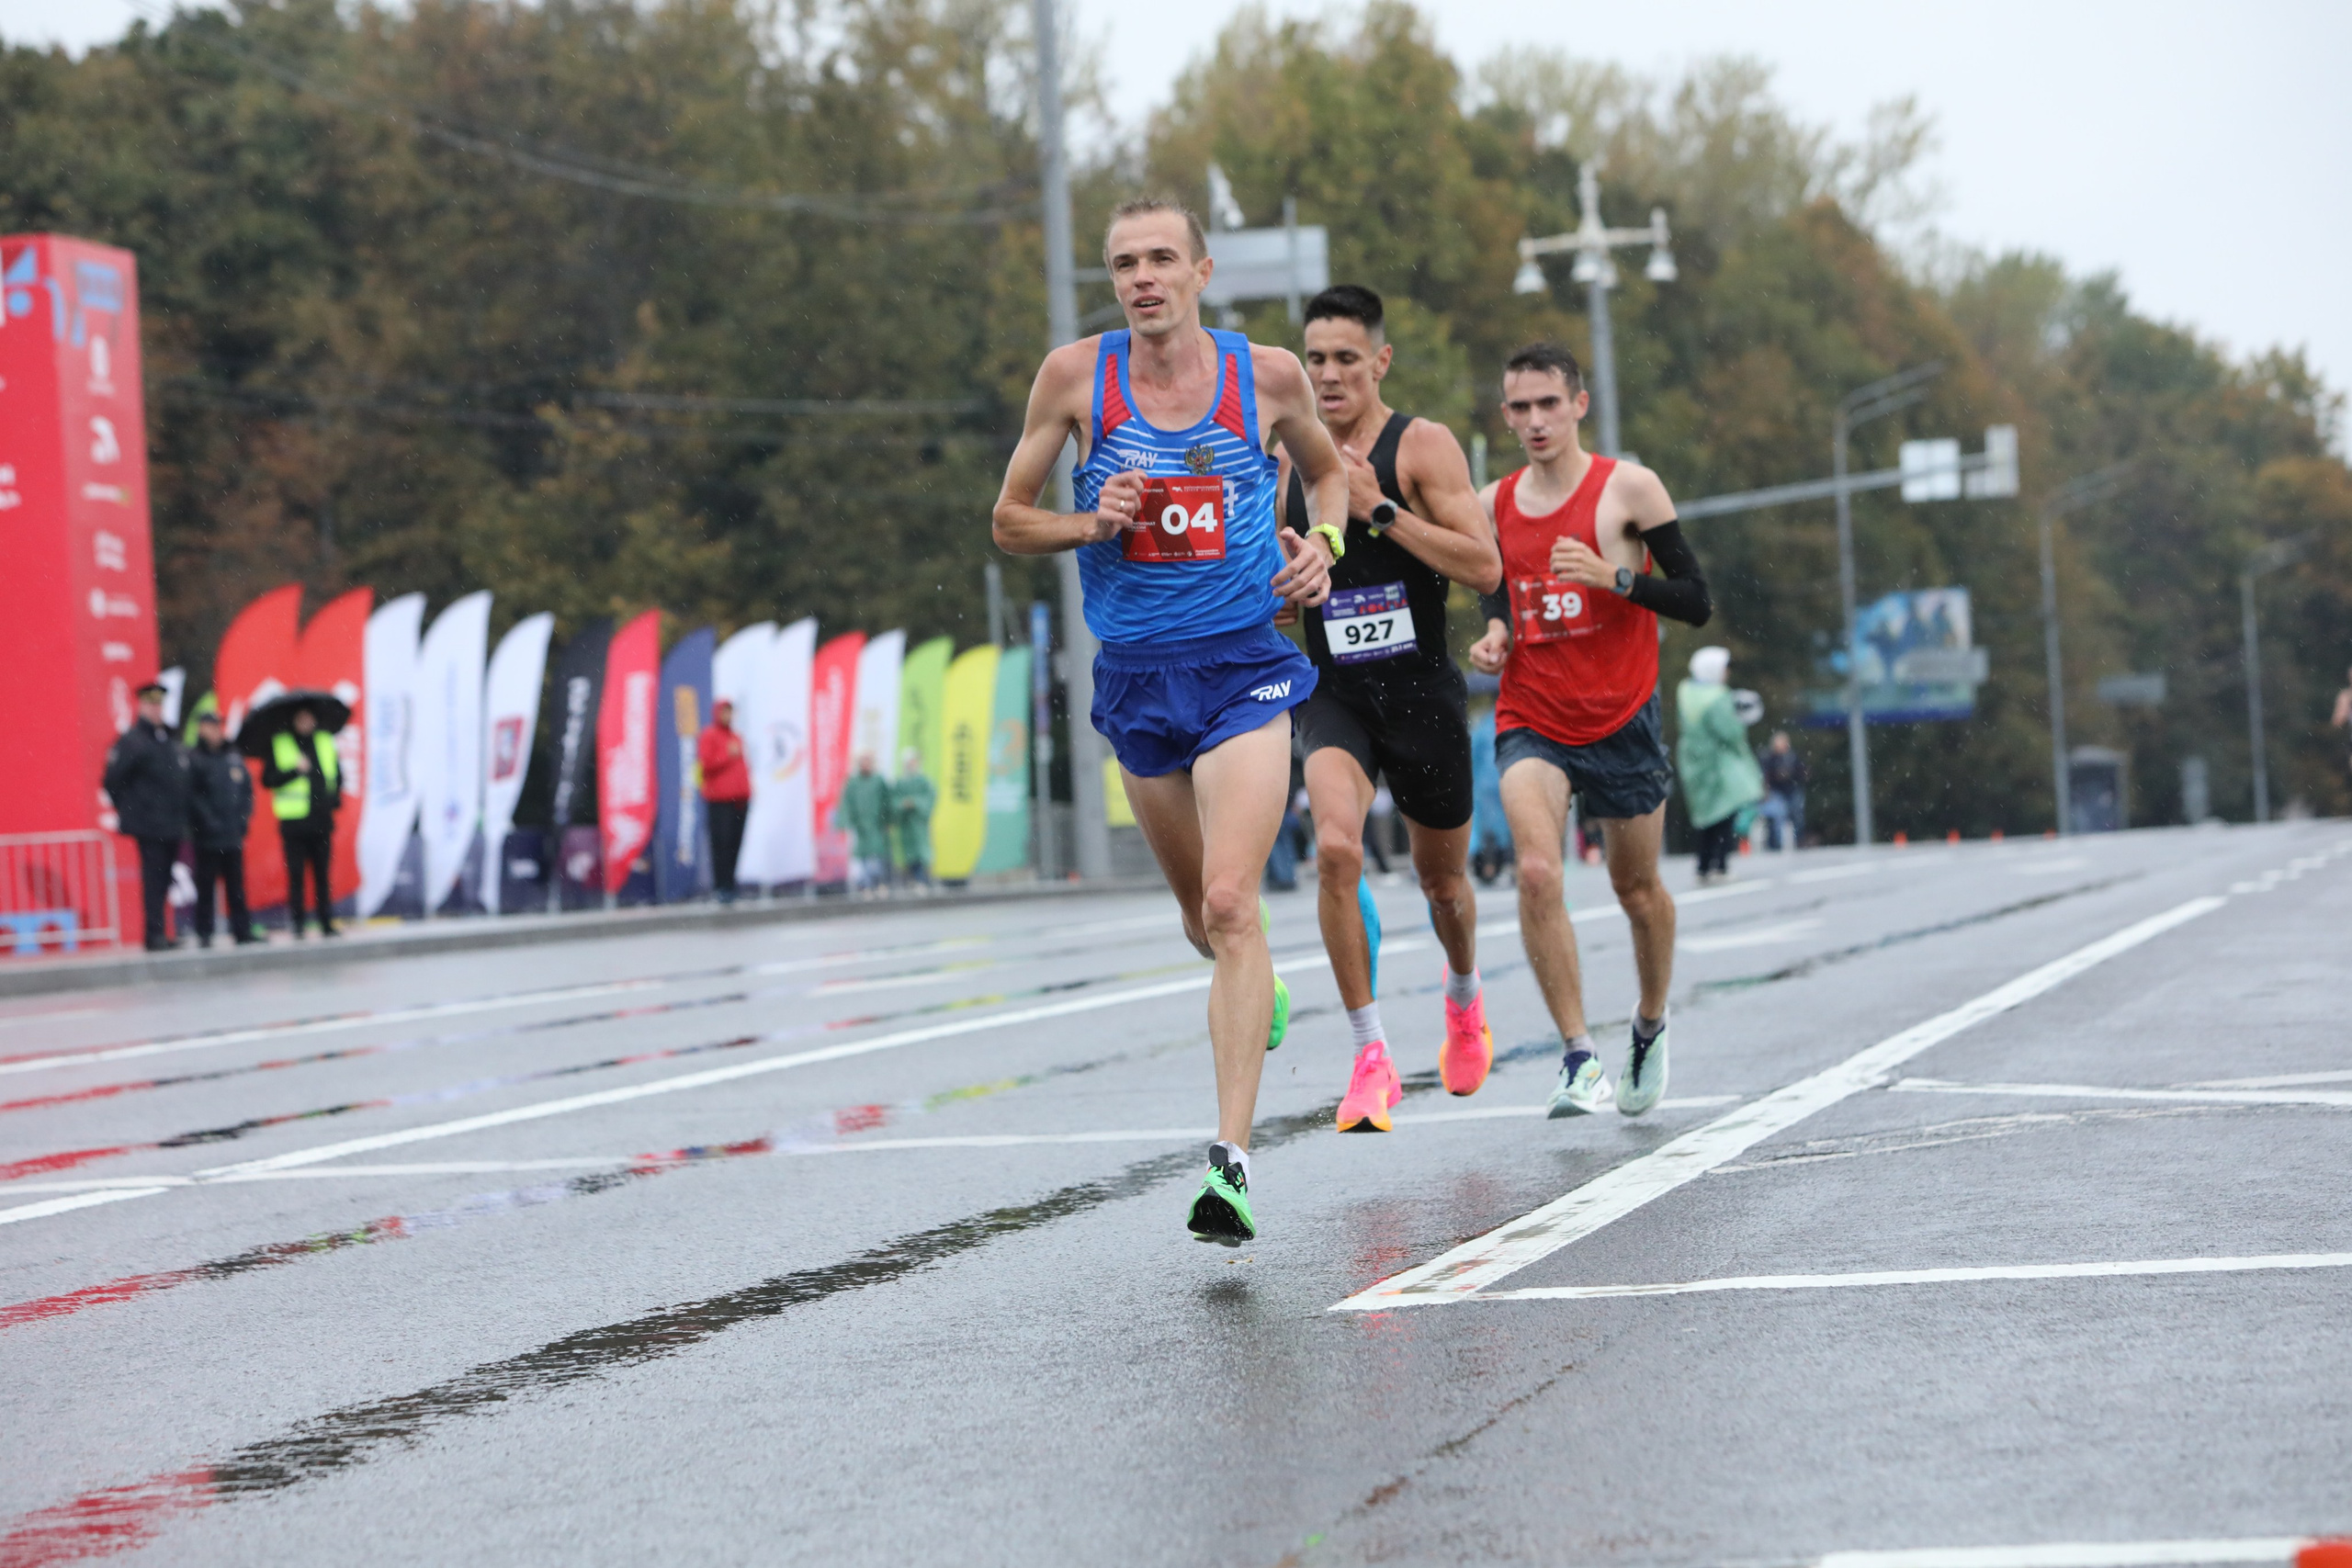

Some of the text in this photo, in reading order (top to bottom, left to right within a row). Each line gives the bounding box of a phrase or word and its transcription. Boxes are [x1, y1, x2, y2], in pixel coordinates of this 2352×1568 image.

[1117, 448, 1158, 468] RAY
[1160, 502, 1218, 536] 04
[1542, 591, 1583, 621] 39
[1345, 618, 1394, 645] 927
[1250, 679, 1292, 702] RAY
